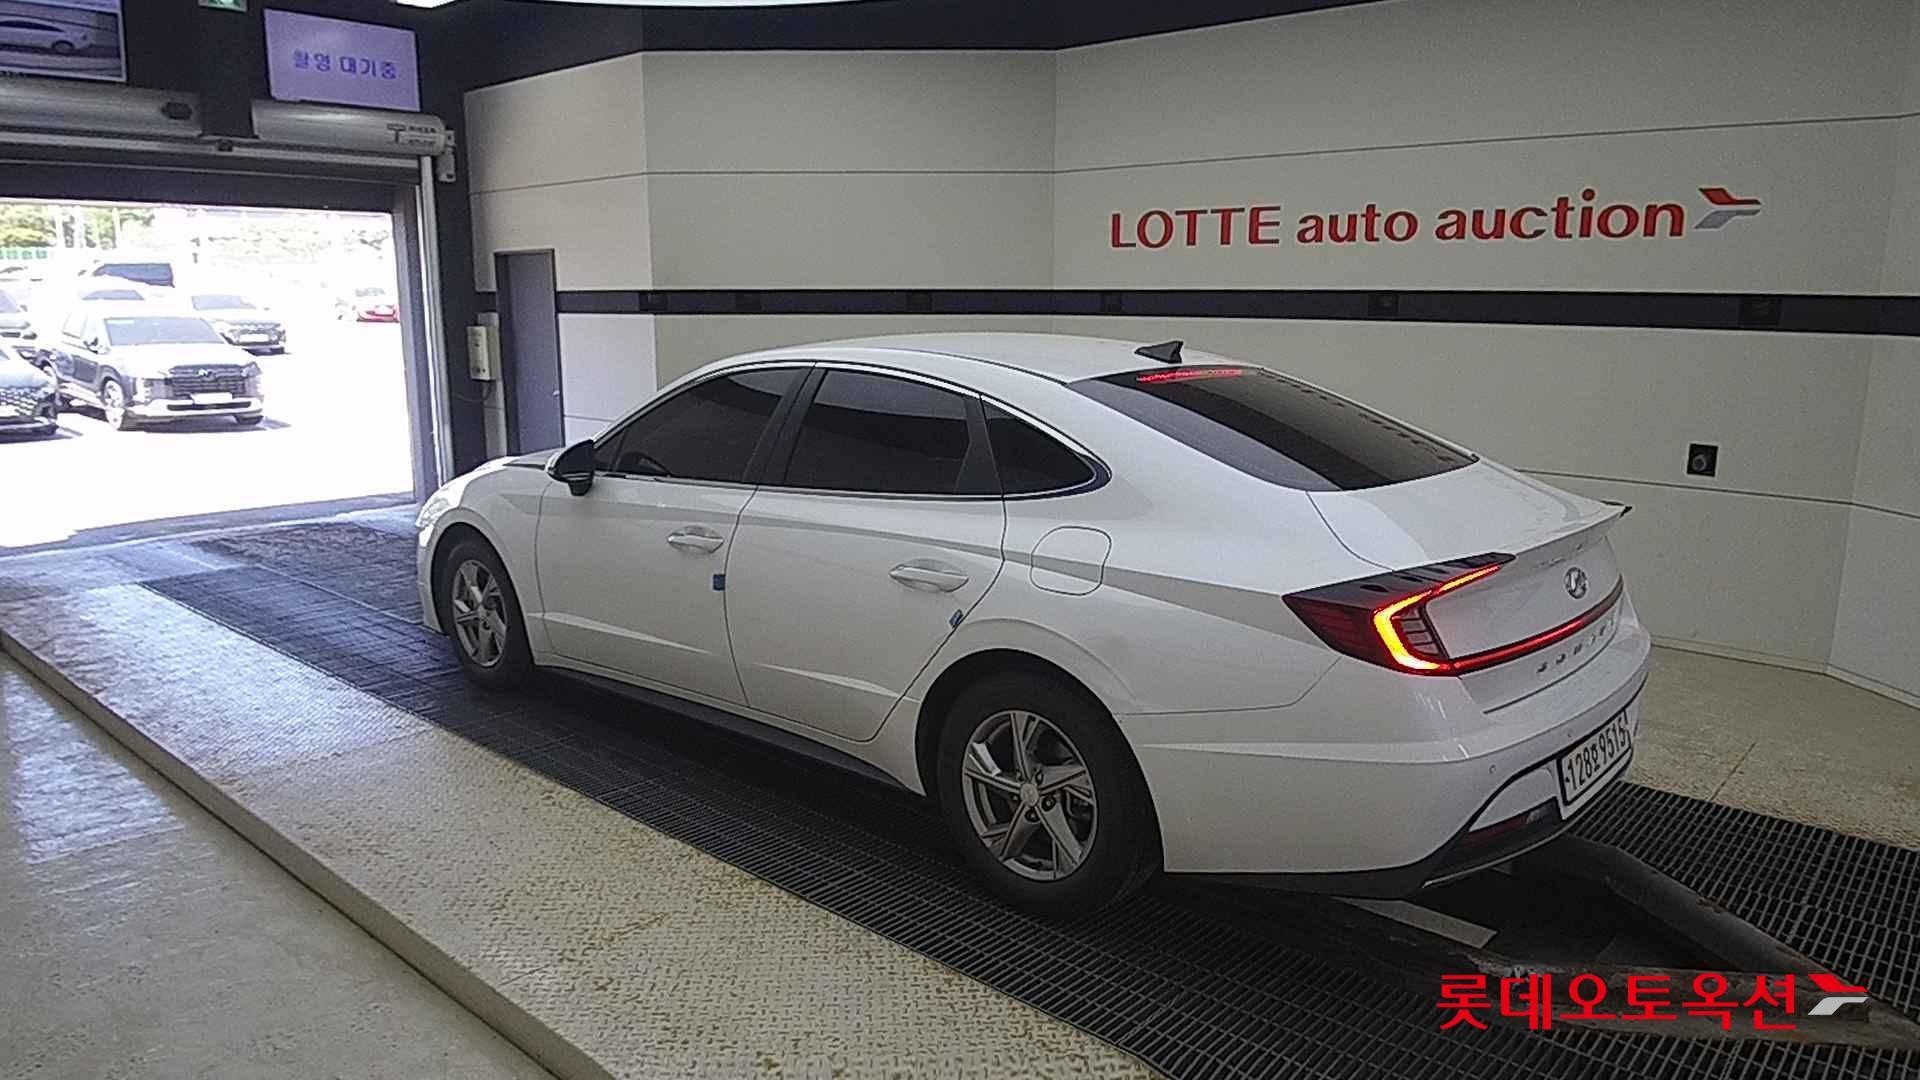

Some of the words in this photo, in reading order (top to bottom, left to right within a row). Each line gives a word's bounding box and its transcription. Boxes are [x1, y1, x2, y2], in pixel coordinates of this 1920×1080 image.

[340, 56, 397, 80] 대기중
[1111, 206, 1281, 249] LOTTE
[1297, 203, 1418, 243] auto
[1435, 189, 1685, 241] auction
